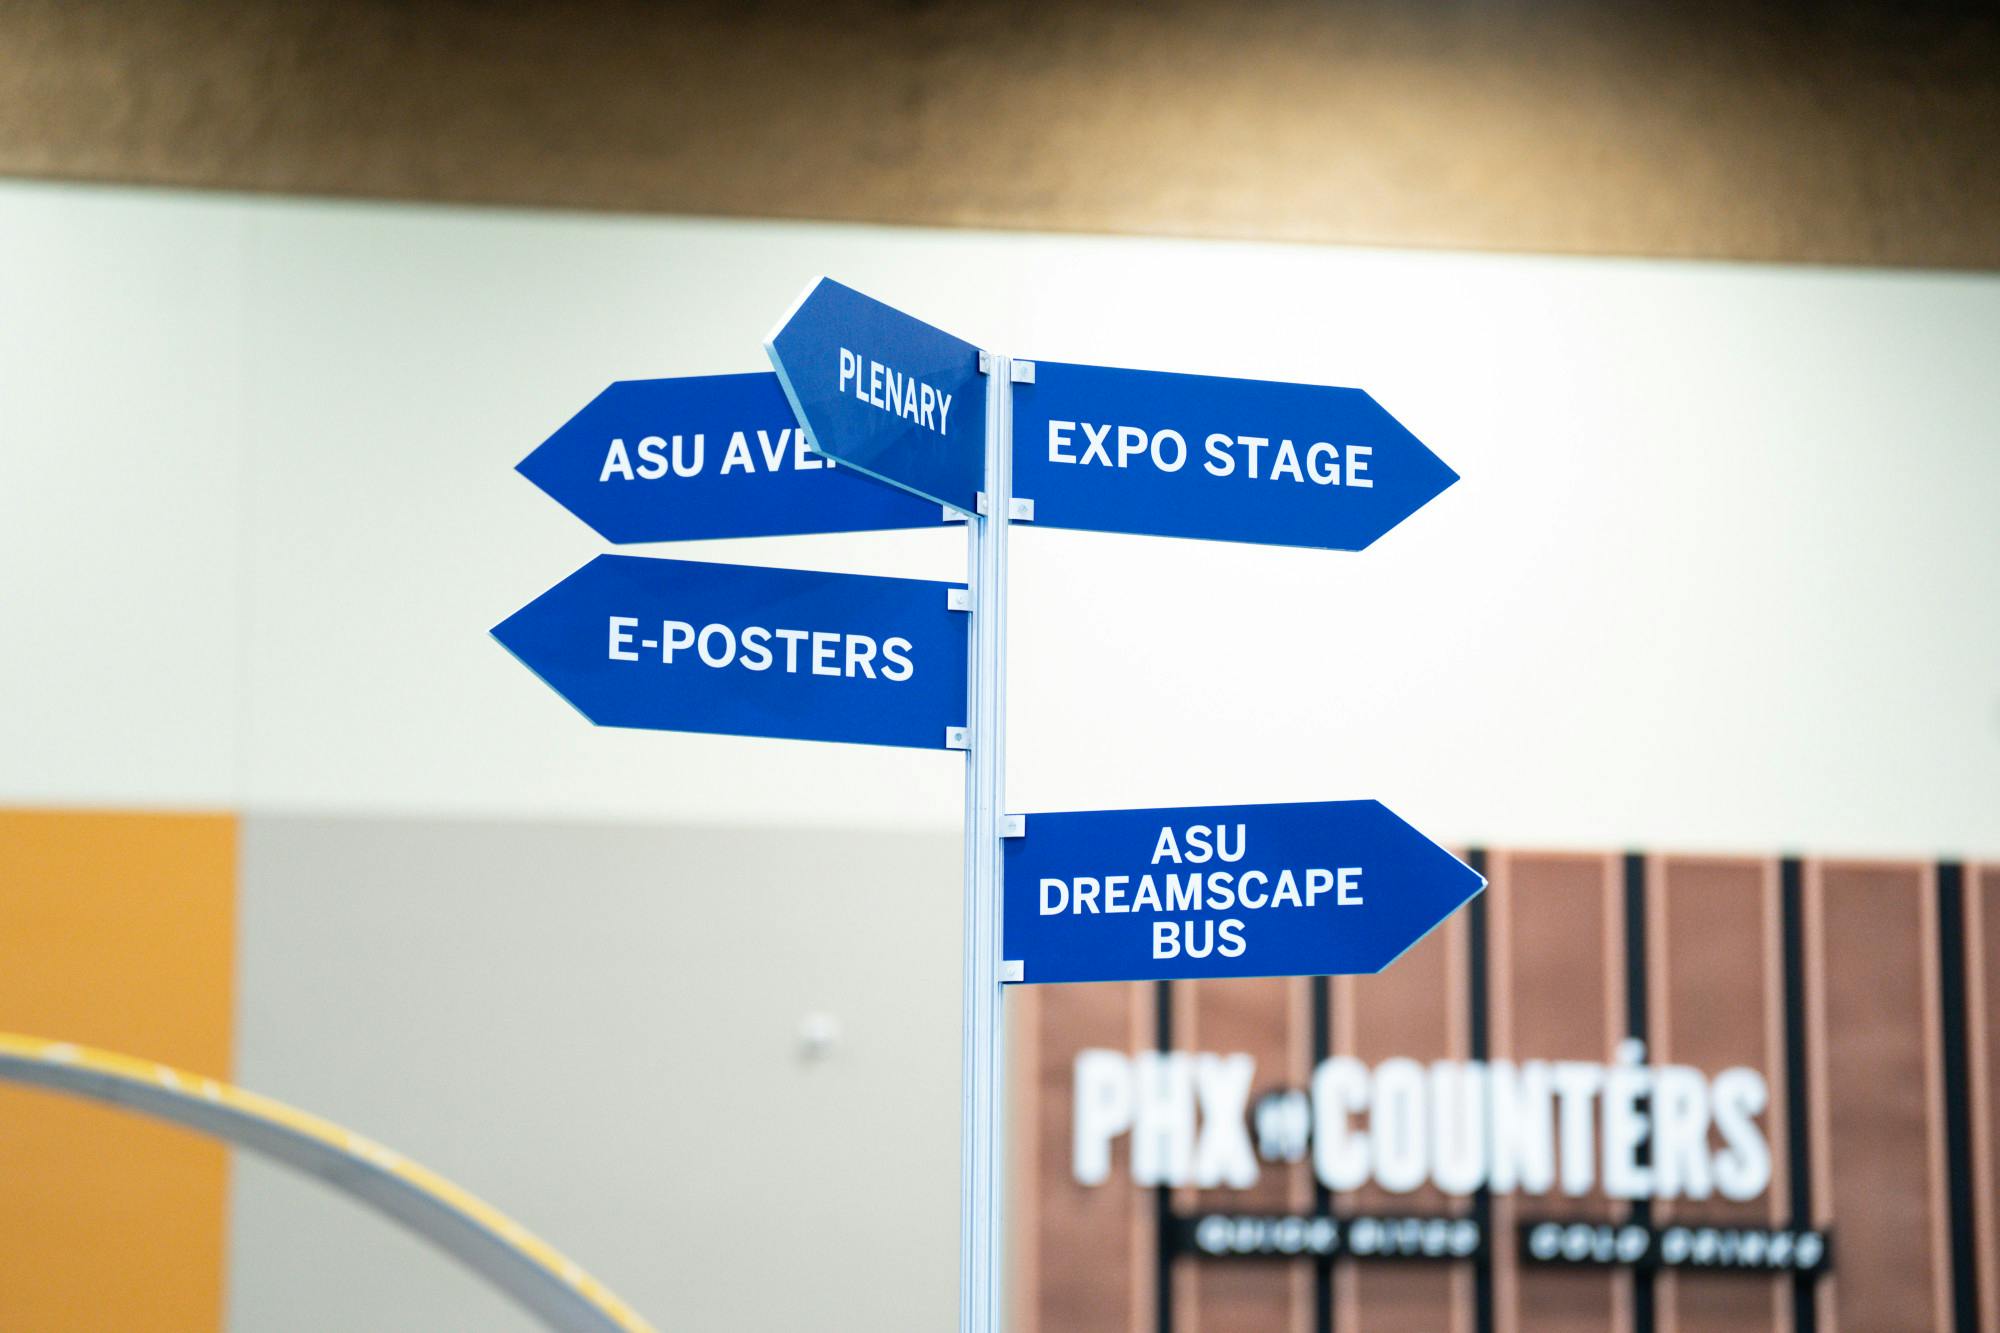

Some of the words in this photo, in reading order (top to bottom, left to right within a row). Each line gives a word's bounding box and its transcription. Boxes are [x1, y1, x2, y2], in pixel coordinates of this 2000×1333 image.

[839, 347, 952, 436] PLENARY
[599, 433, 705, 482] ASU
[720, 428, 836, 474] AVE
[1048, 419, 1187, 473] EXPO
[1203, 433, 1374, 489] STAGE
[608, 615, 914, 683] E-POSTERS
[1150, 823, 1246, 865] ASU
[1039, 867, 1364, 916] DREAMSCAPE
[1152, 918, 1247, 960] BUS
[1074, 1049, 1259, 1189] PHX
